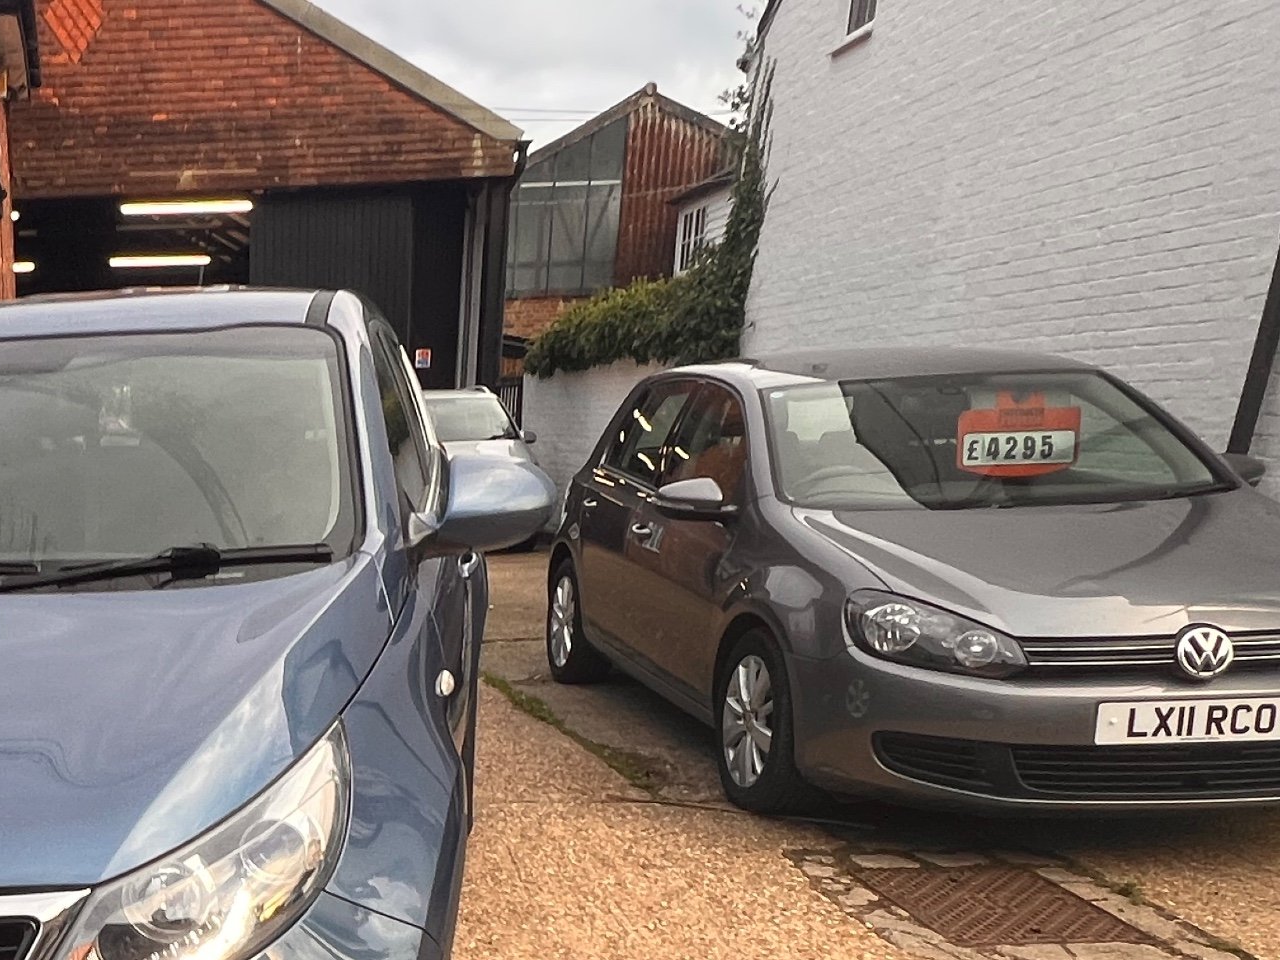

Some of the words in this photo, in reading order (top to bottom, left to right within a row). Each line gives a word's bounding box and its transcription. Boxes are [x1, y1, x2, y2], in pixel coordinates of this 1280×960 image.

[967, 435, 1054, 461] £4295
[1126, 705, 1196, 737] LX11
[1205, 703, 1277, 735] RCO
